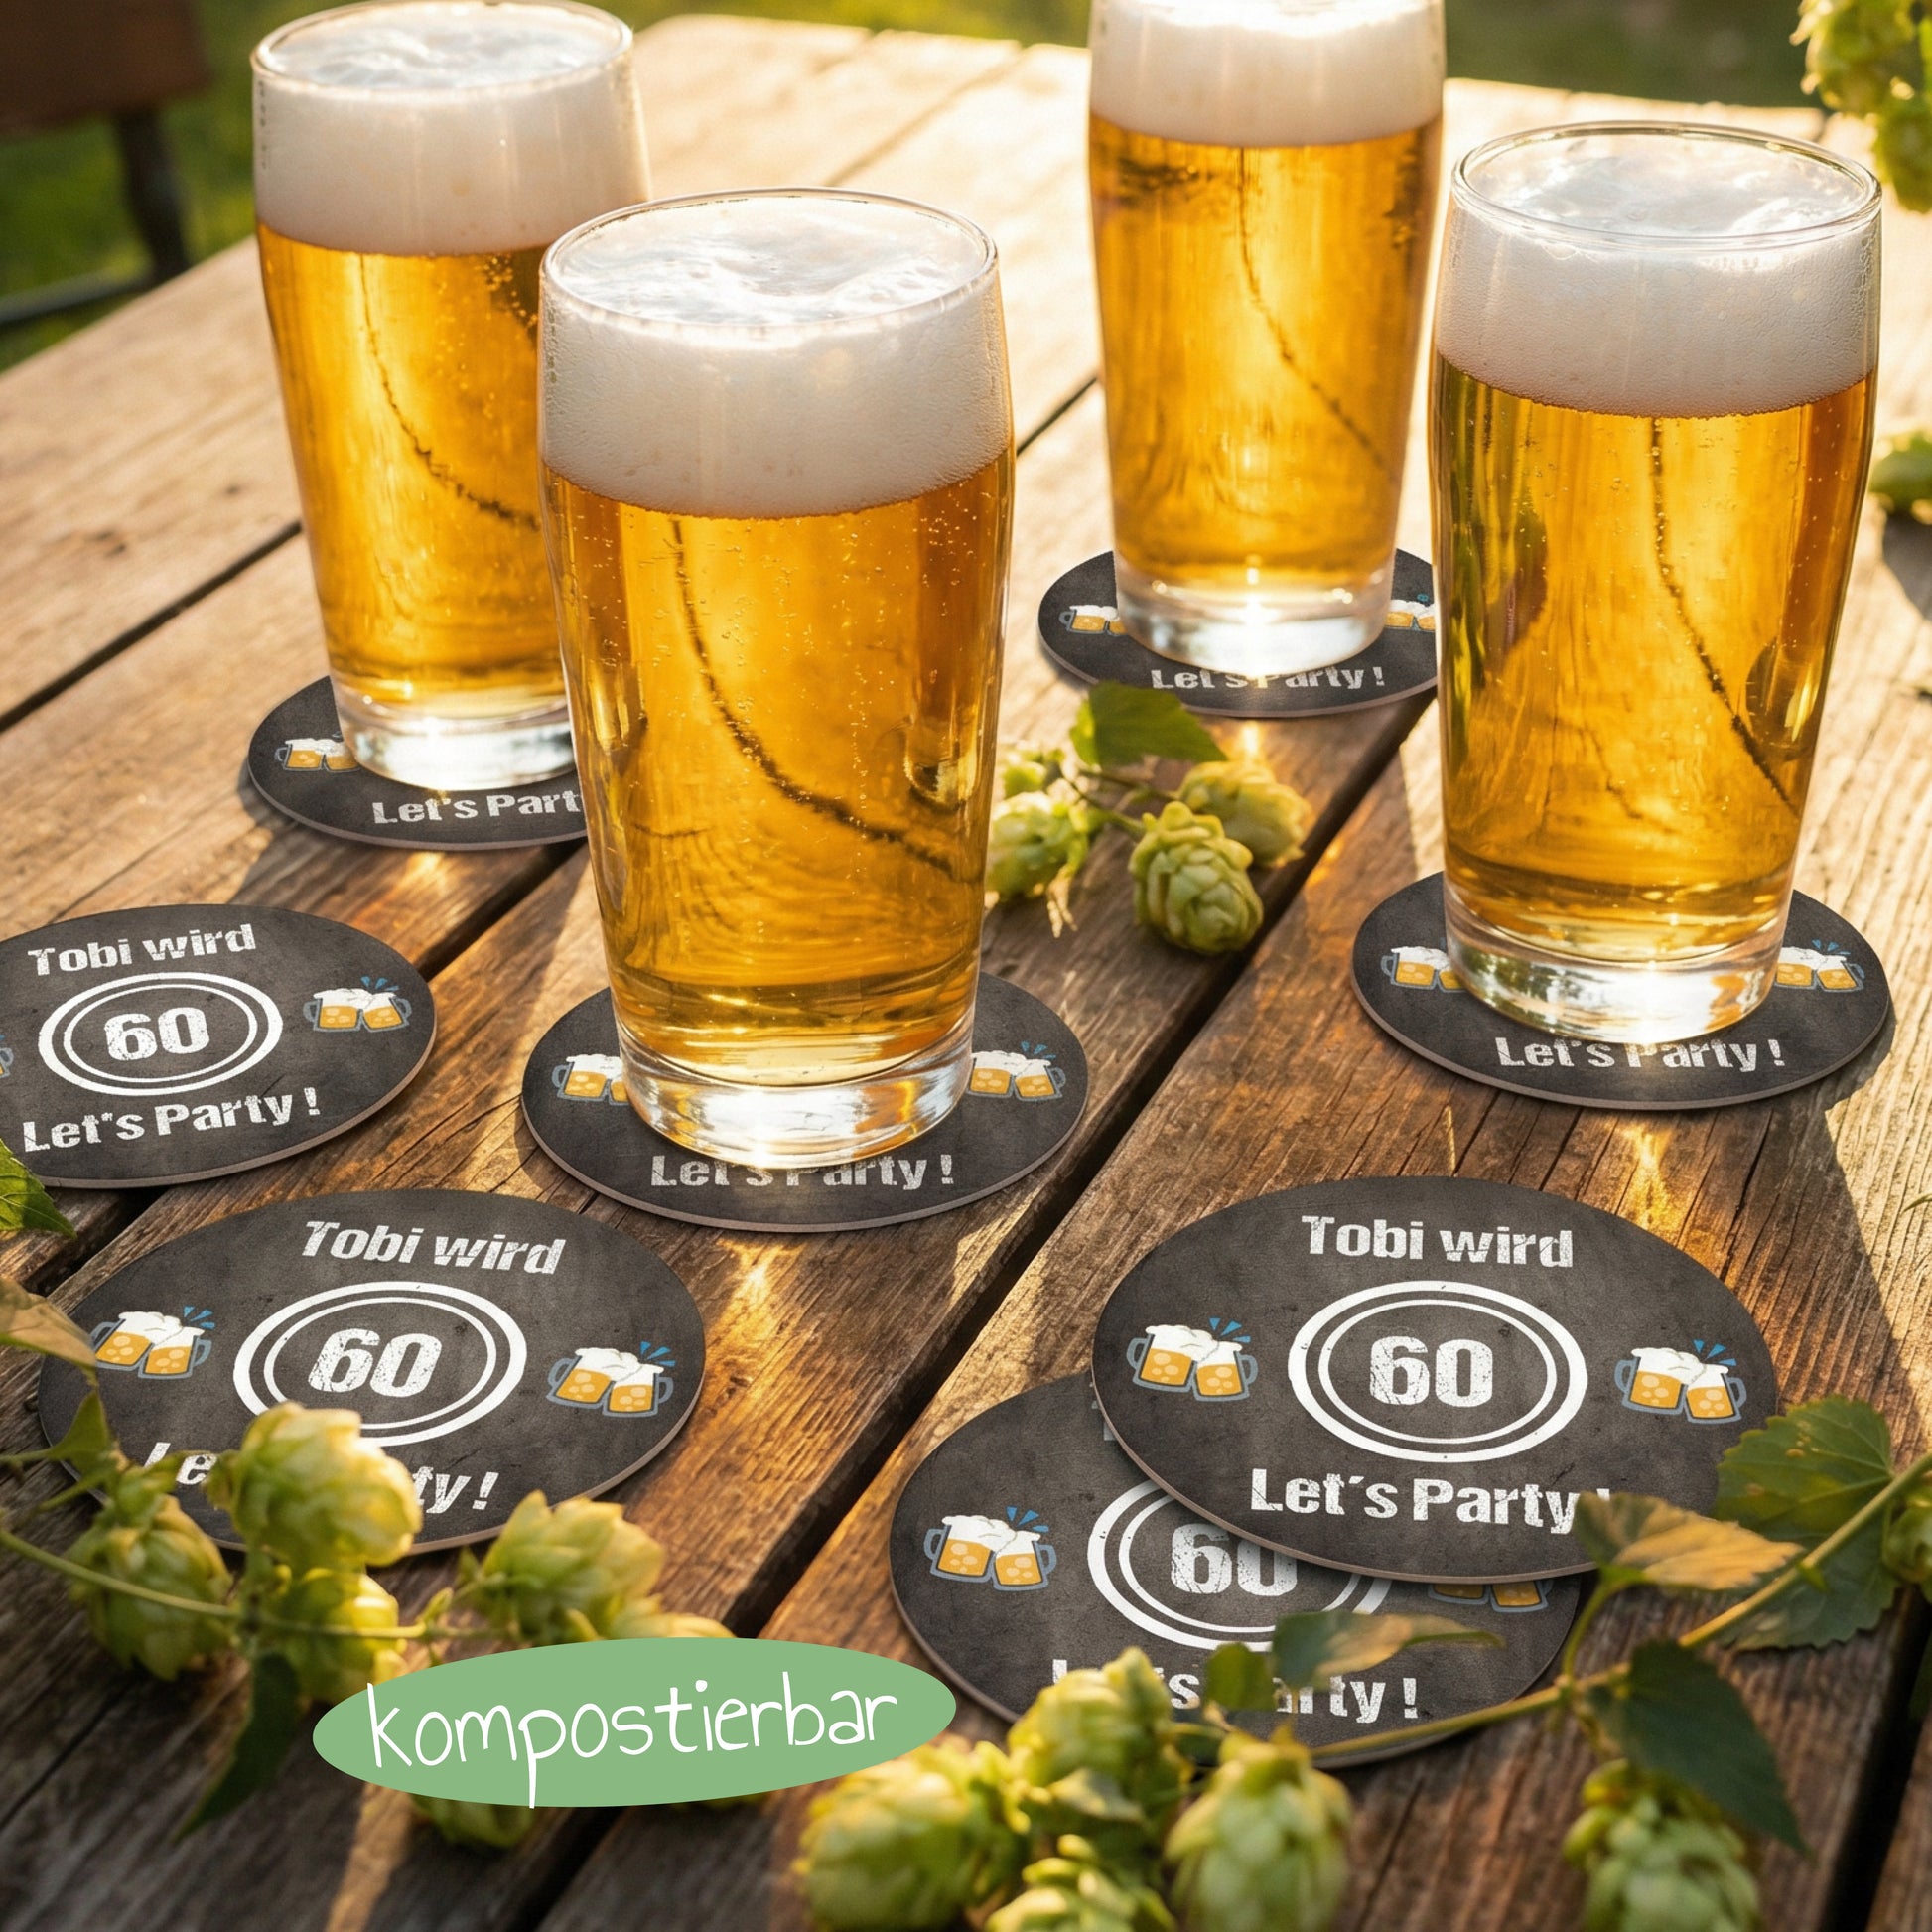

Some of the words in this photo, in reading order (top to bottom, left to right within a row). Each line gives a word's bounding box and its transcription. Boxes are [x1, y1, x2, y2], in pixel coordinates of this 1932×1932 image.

[1151, 668, 1248, 689] Lets
[486, 790, 581, 817] Part
[28, 938, 132, 976] Tobi
[142, 923, 256, 961] wird
[103, 1007, 210, 1061] 60
[154, 1094, 293, 1137] Party
[651, 1155, 773, 1186] Lets
[301, 1220, 424, 1264] Tobi
[434, 1234, 566, 1275] wird
[1302, 1215, 1424, 1260] Tobi
[1439, 1225, 1574, 1268] wird
[308, 1327, 443, 1398] 60
[1369, 1335, 1493, 1408] 60
[1413, 1478, 1581, 1535] Party
[1170, 1523, 1298, 1596] 60
